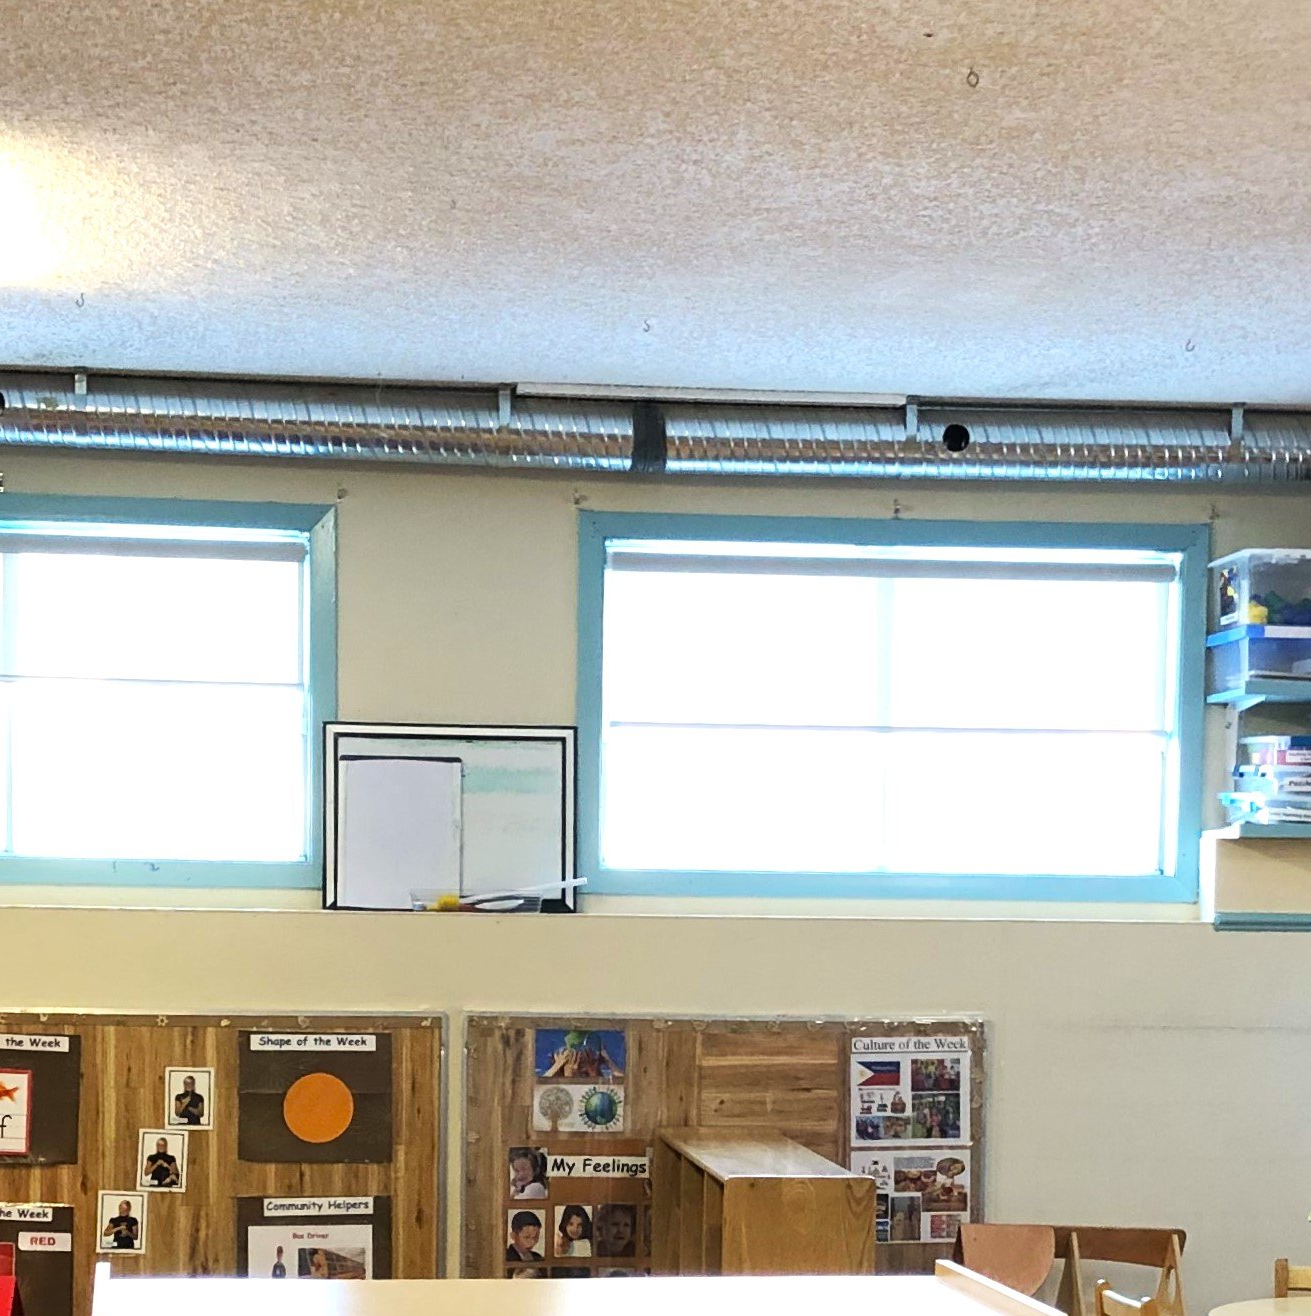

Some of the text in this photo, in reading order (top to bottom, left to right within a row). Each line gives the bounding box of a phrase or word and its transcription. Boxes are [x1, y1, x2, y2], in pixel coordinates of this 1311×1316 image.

[5, 1037, 24, 1047] the
[29, 1038, 61, 1048] Week
[259, 1036, 367, 1048] Shape of the Week
[853, 1038, 967, 1051] Culture of the Week
[551, 1158, 647, 1176] My Feelings
[266, 1201, 369, 1213] Community Helpers
[17, 1208, 49, 1219] Week
[29, 1237, 56, 1246] RED
